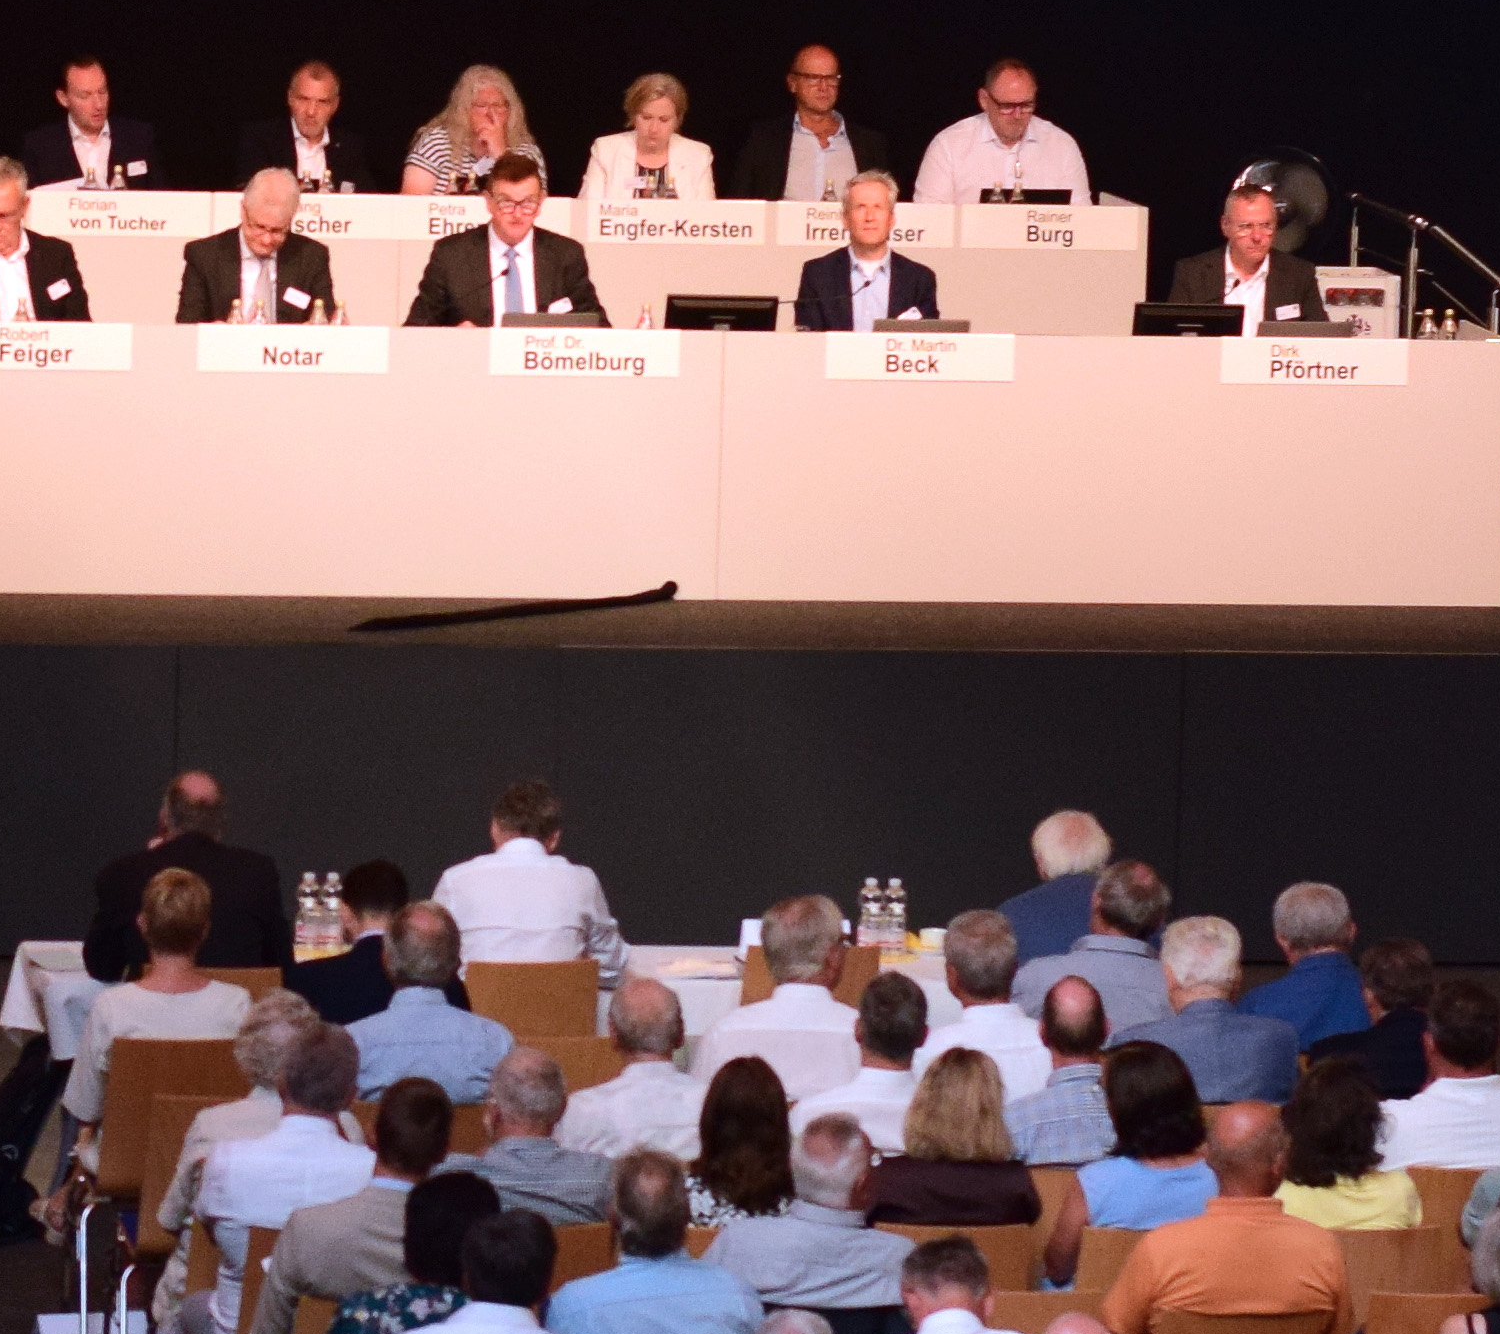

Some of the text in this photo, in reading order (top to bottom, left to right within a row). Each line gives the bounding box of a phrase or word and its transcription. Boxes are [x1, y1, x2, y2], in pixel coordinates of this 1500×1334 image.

[69, 197, 117, 211] Florian
[429, 202, 467, 215] Petra
[600, 203, 639, 216] Maria
[806, 207, 842, 220] Rein
[1027, 211, 1073, 224] Rainer
[69, 215, 167, 232] von Tucher
[294, 218, 351, 234] scher
[600, 219, 753, 242] Engfer-Kersten
[1027, 225, 1074, 247] Burg
[0, 327, 50, 342] Robert
[912, 338, 957, 353] Martin
[1271, 345, 1300, 358] Dirk
[0, 344, 73, 367] Feiger
[263, 347, 324, 366] Notar
[524, 351, 646, 376] Bömelburg
[886, 355, 939, 374] Beck
[1270, 359, 1358, 381] Pförtner
